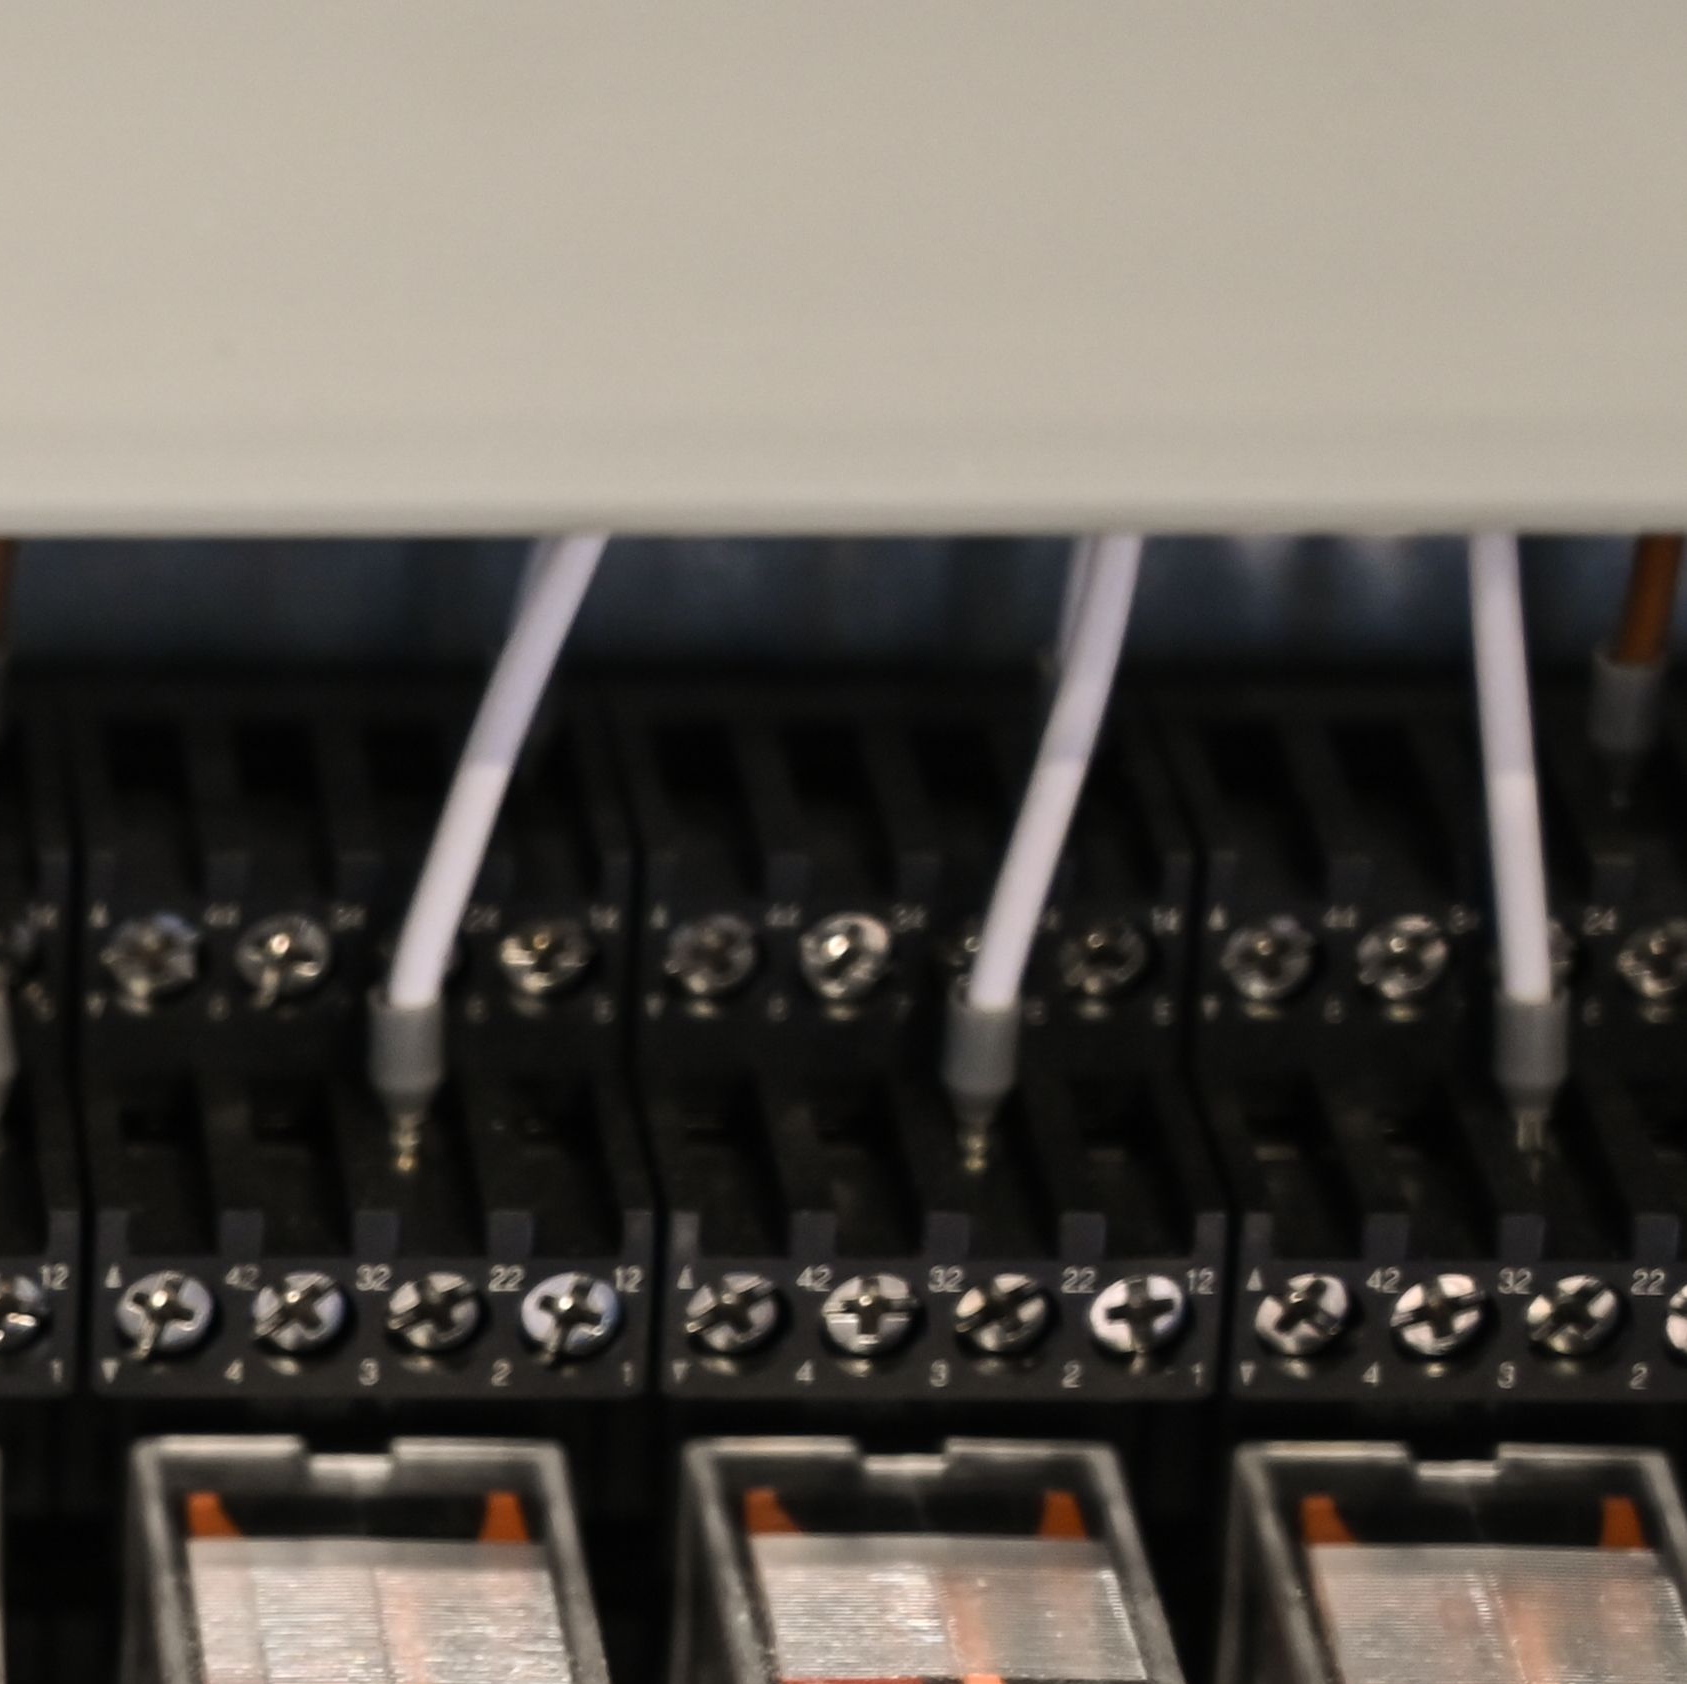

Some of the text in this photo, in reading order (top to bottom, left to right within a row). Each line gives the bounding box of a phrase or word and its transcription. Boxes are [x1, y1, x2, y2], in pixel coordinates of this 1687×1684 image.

[41, 1264, 68, 1290] 12
[225, 1264, 642, 1292] 42 32 22 12
[796, 1265, 1214, 1294] 42 32 22 12
[1366, 1267, 1665, 1295] 42 32 22
[225, 1360, 243, 1382] 4
[360, 1359, 378, 1385] 3
[491, 1359, 511, 1386] 2
[796, 1361, 814, 1382] 4
[930, 1361, 948, 1387] 3
[1062, 1362, 1081, 1388] 2
[1363, 1362, 1648, 1389] 4 3 2
